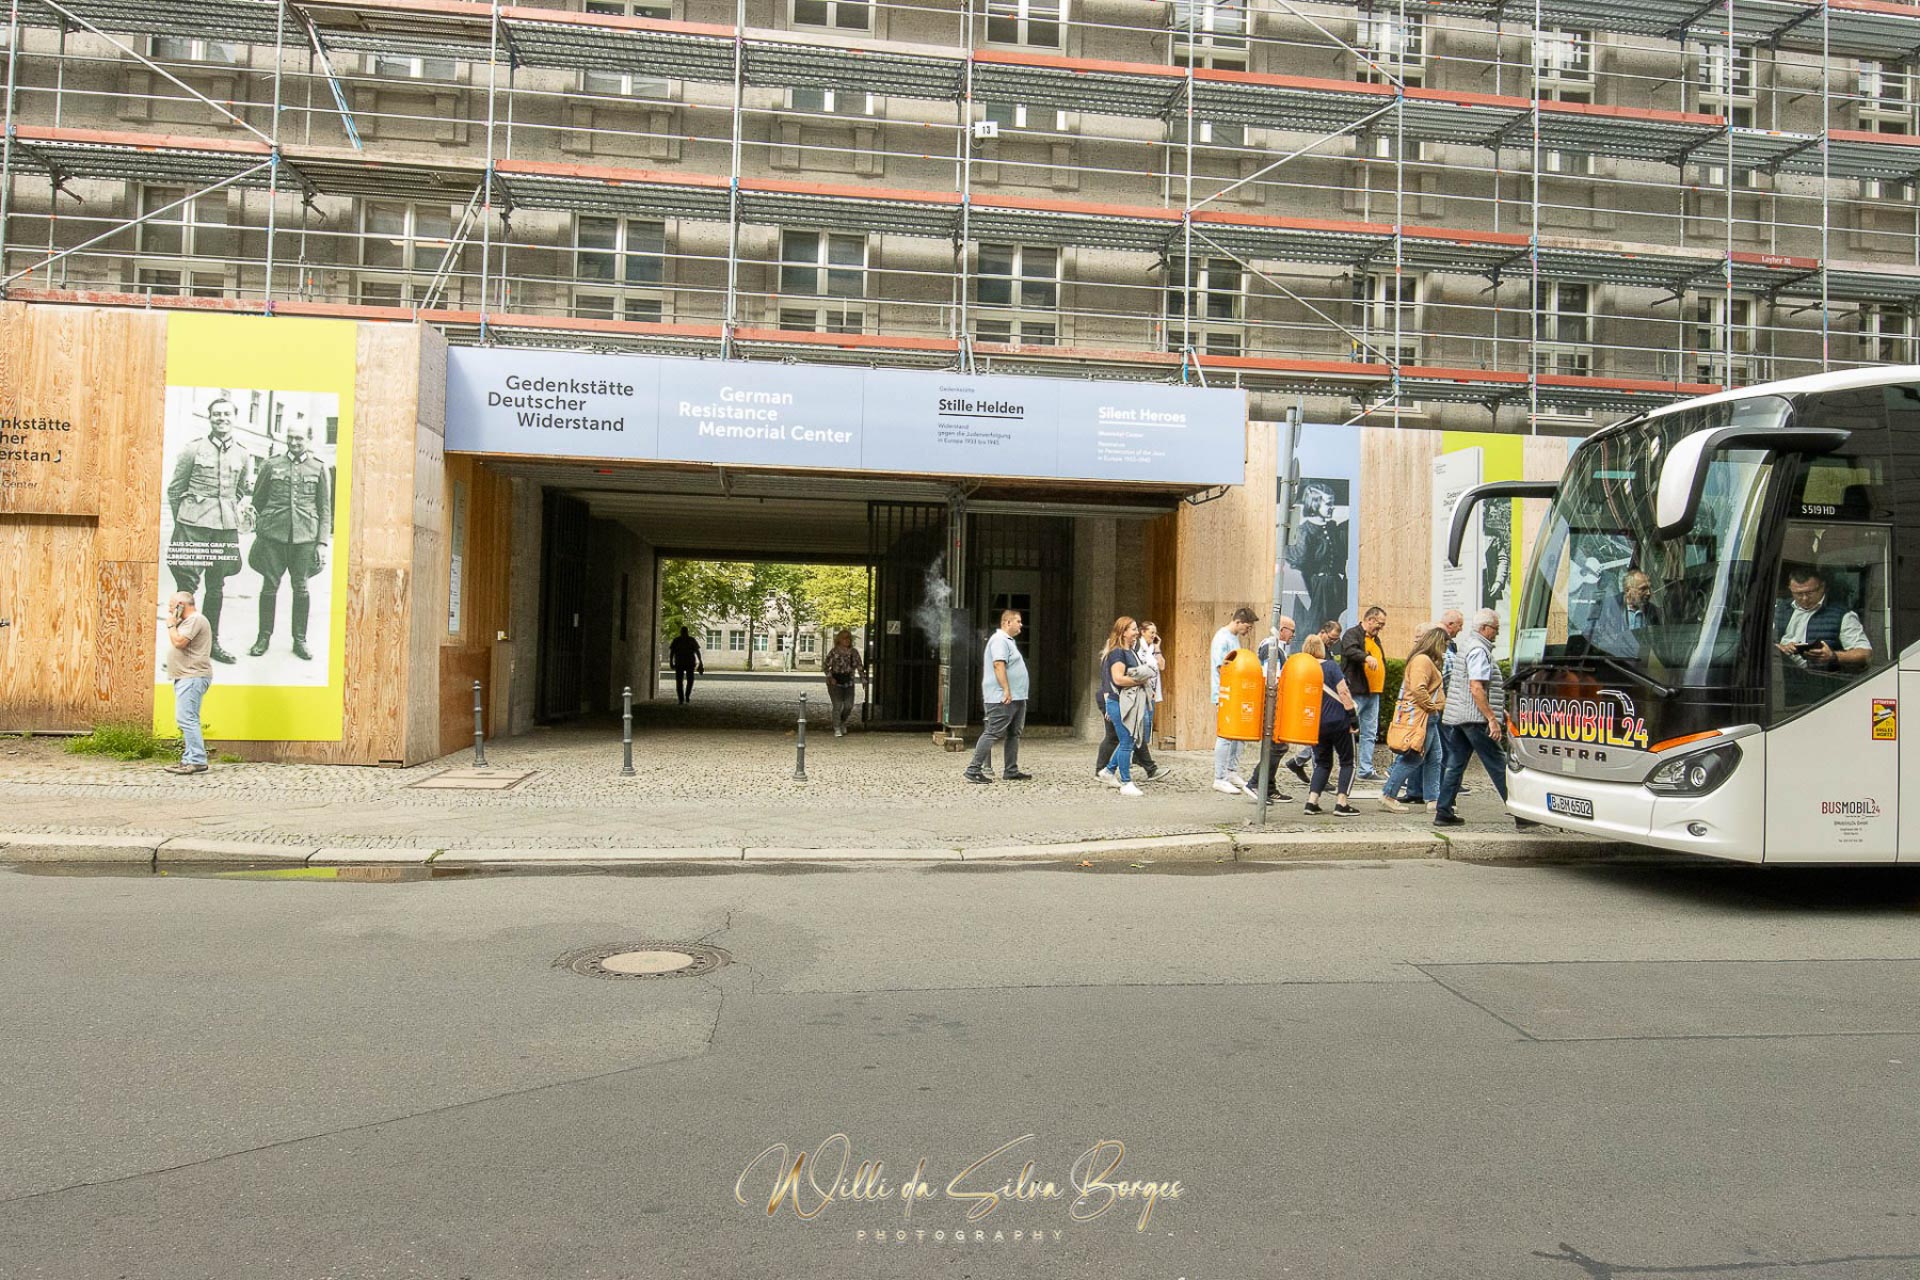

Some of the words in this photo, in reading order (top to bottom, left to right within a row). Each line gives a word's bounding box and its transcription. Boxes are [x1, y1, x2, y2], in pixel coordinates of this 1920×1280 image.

[982, 125, 991, 135] 13
[506, 375, 634, 396] Gedenkstätte
[488, 391, 587, 411] Deutscher
[720, 386, 793, 405] German
[679, 402, 778, 421] Resistance
[939, 398, 973, 412] Stille
[976, 400, 1024, 414] Helden
[1098, 406, 1137, 420] Silent
[1140, 408, 1187, 423] Heroes
[517, 411, 624, 432] Widerstand
[698, 421, 786, 440] Memorial
[791, 425, 853, 443] Center
[1519, 698, 1648, 748] BUSMOBIL24
[1538, 744, 1607, 762] SETRA
